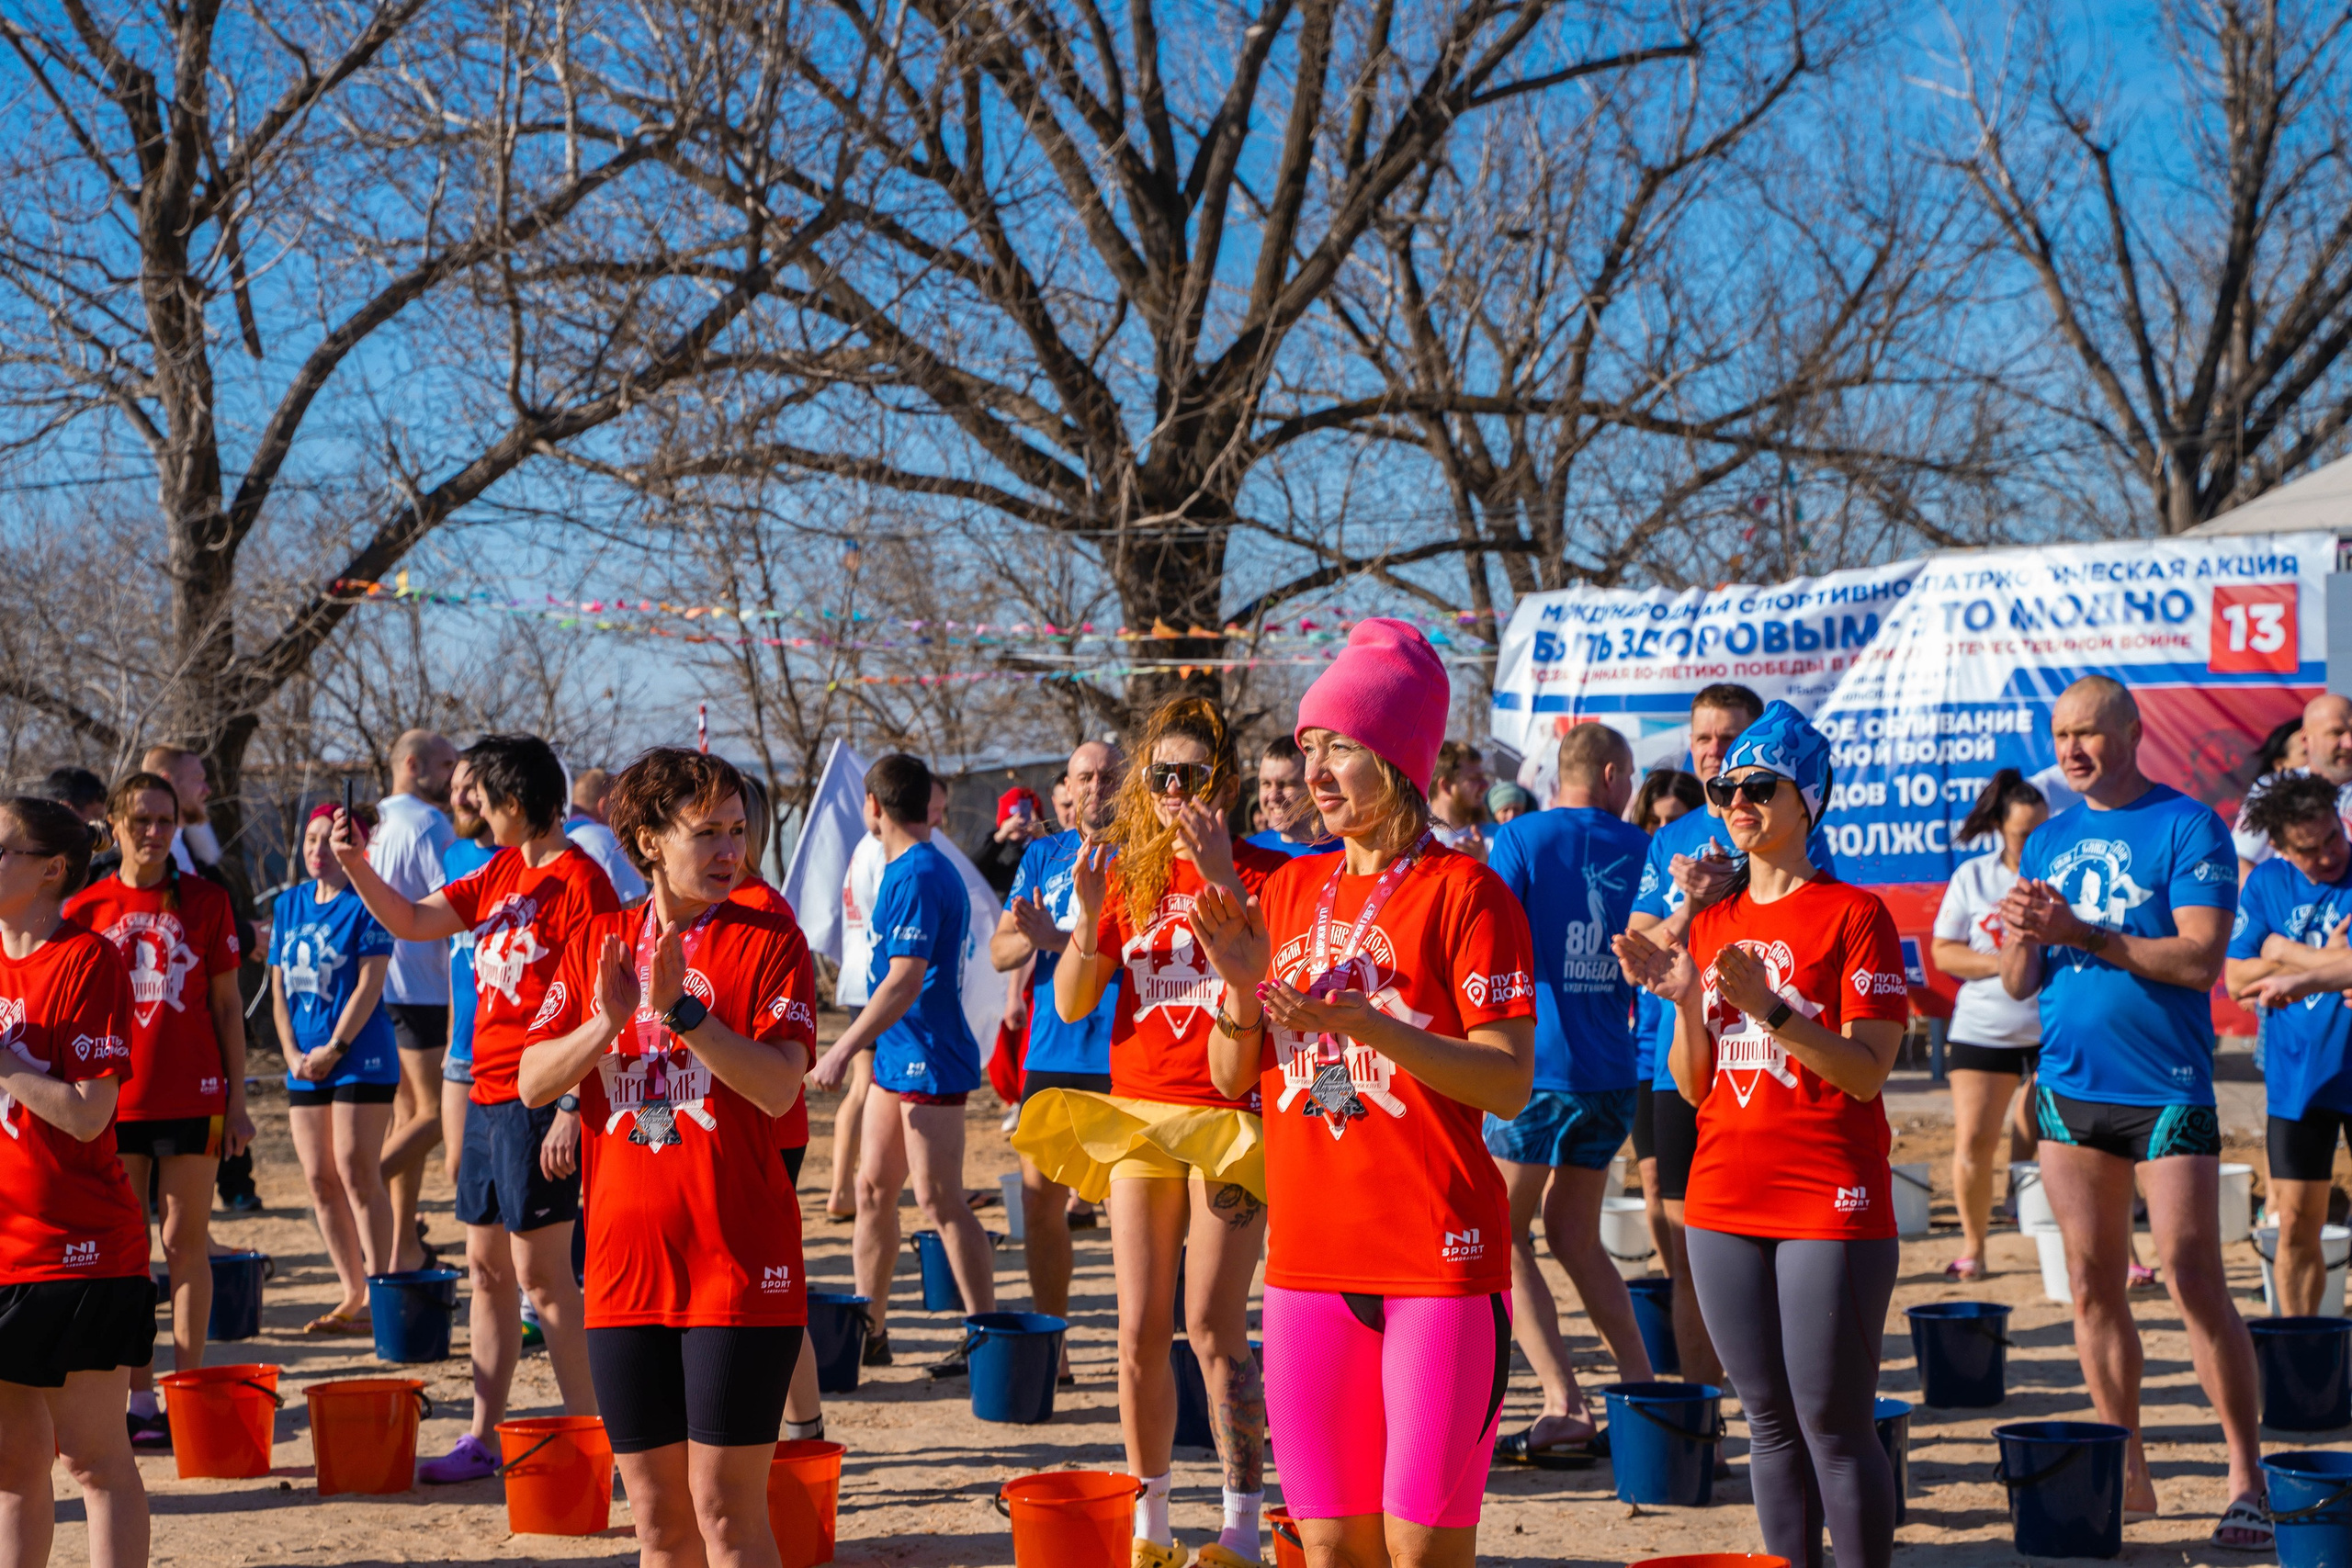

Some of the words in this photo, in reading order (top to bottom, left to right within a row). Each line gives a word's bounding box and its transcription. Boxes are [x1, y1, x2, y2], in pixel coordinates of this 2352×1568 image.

[2197, 554, 2298, 580] АКЦИЯ
[1618, 613, 1880, 660] ЗДОРОВЫМ
[2009, 589, 2195, 632] МОДНО
[2222, 603, 2286, 653] 13
[2120, 630, 2193, 649] ВОЙНЕ
[1735, 659, 1824, 677] ПОБЕДЫ
[1863, 708, 2033, 739] ОБЛИВАНИЕ
[1897, 733, 1996, 765] ВОДОЙ
[1894, 773, 1939, 808] 10
[1566, 920, 1603, 955] 80
[1490, 970, 1529, 988] ПУТЬ
[1564, 960, 1618, 982] ПОБЕДА
[1874, 973, 1902, 985] ПУТЬ
[1492, 984, 1533, 1003] ДОМО
[95, 1035, 123, 1047] ПУТЬ
[1721, 1037, 1777, 1061] РОПОЛК
[1834, 1199, 1870, 1208] SPORT
[62, 1253, 100, 1264] SPORT
[1442, 1245, 1485, 1257] SPORT
[761, 1280, 791, 1289] SPORT
